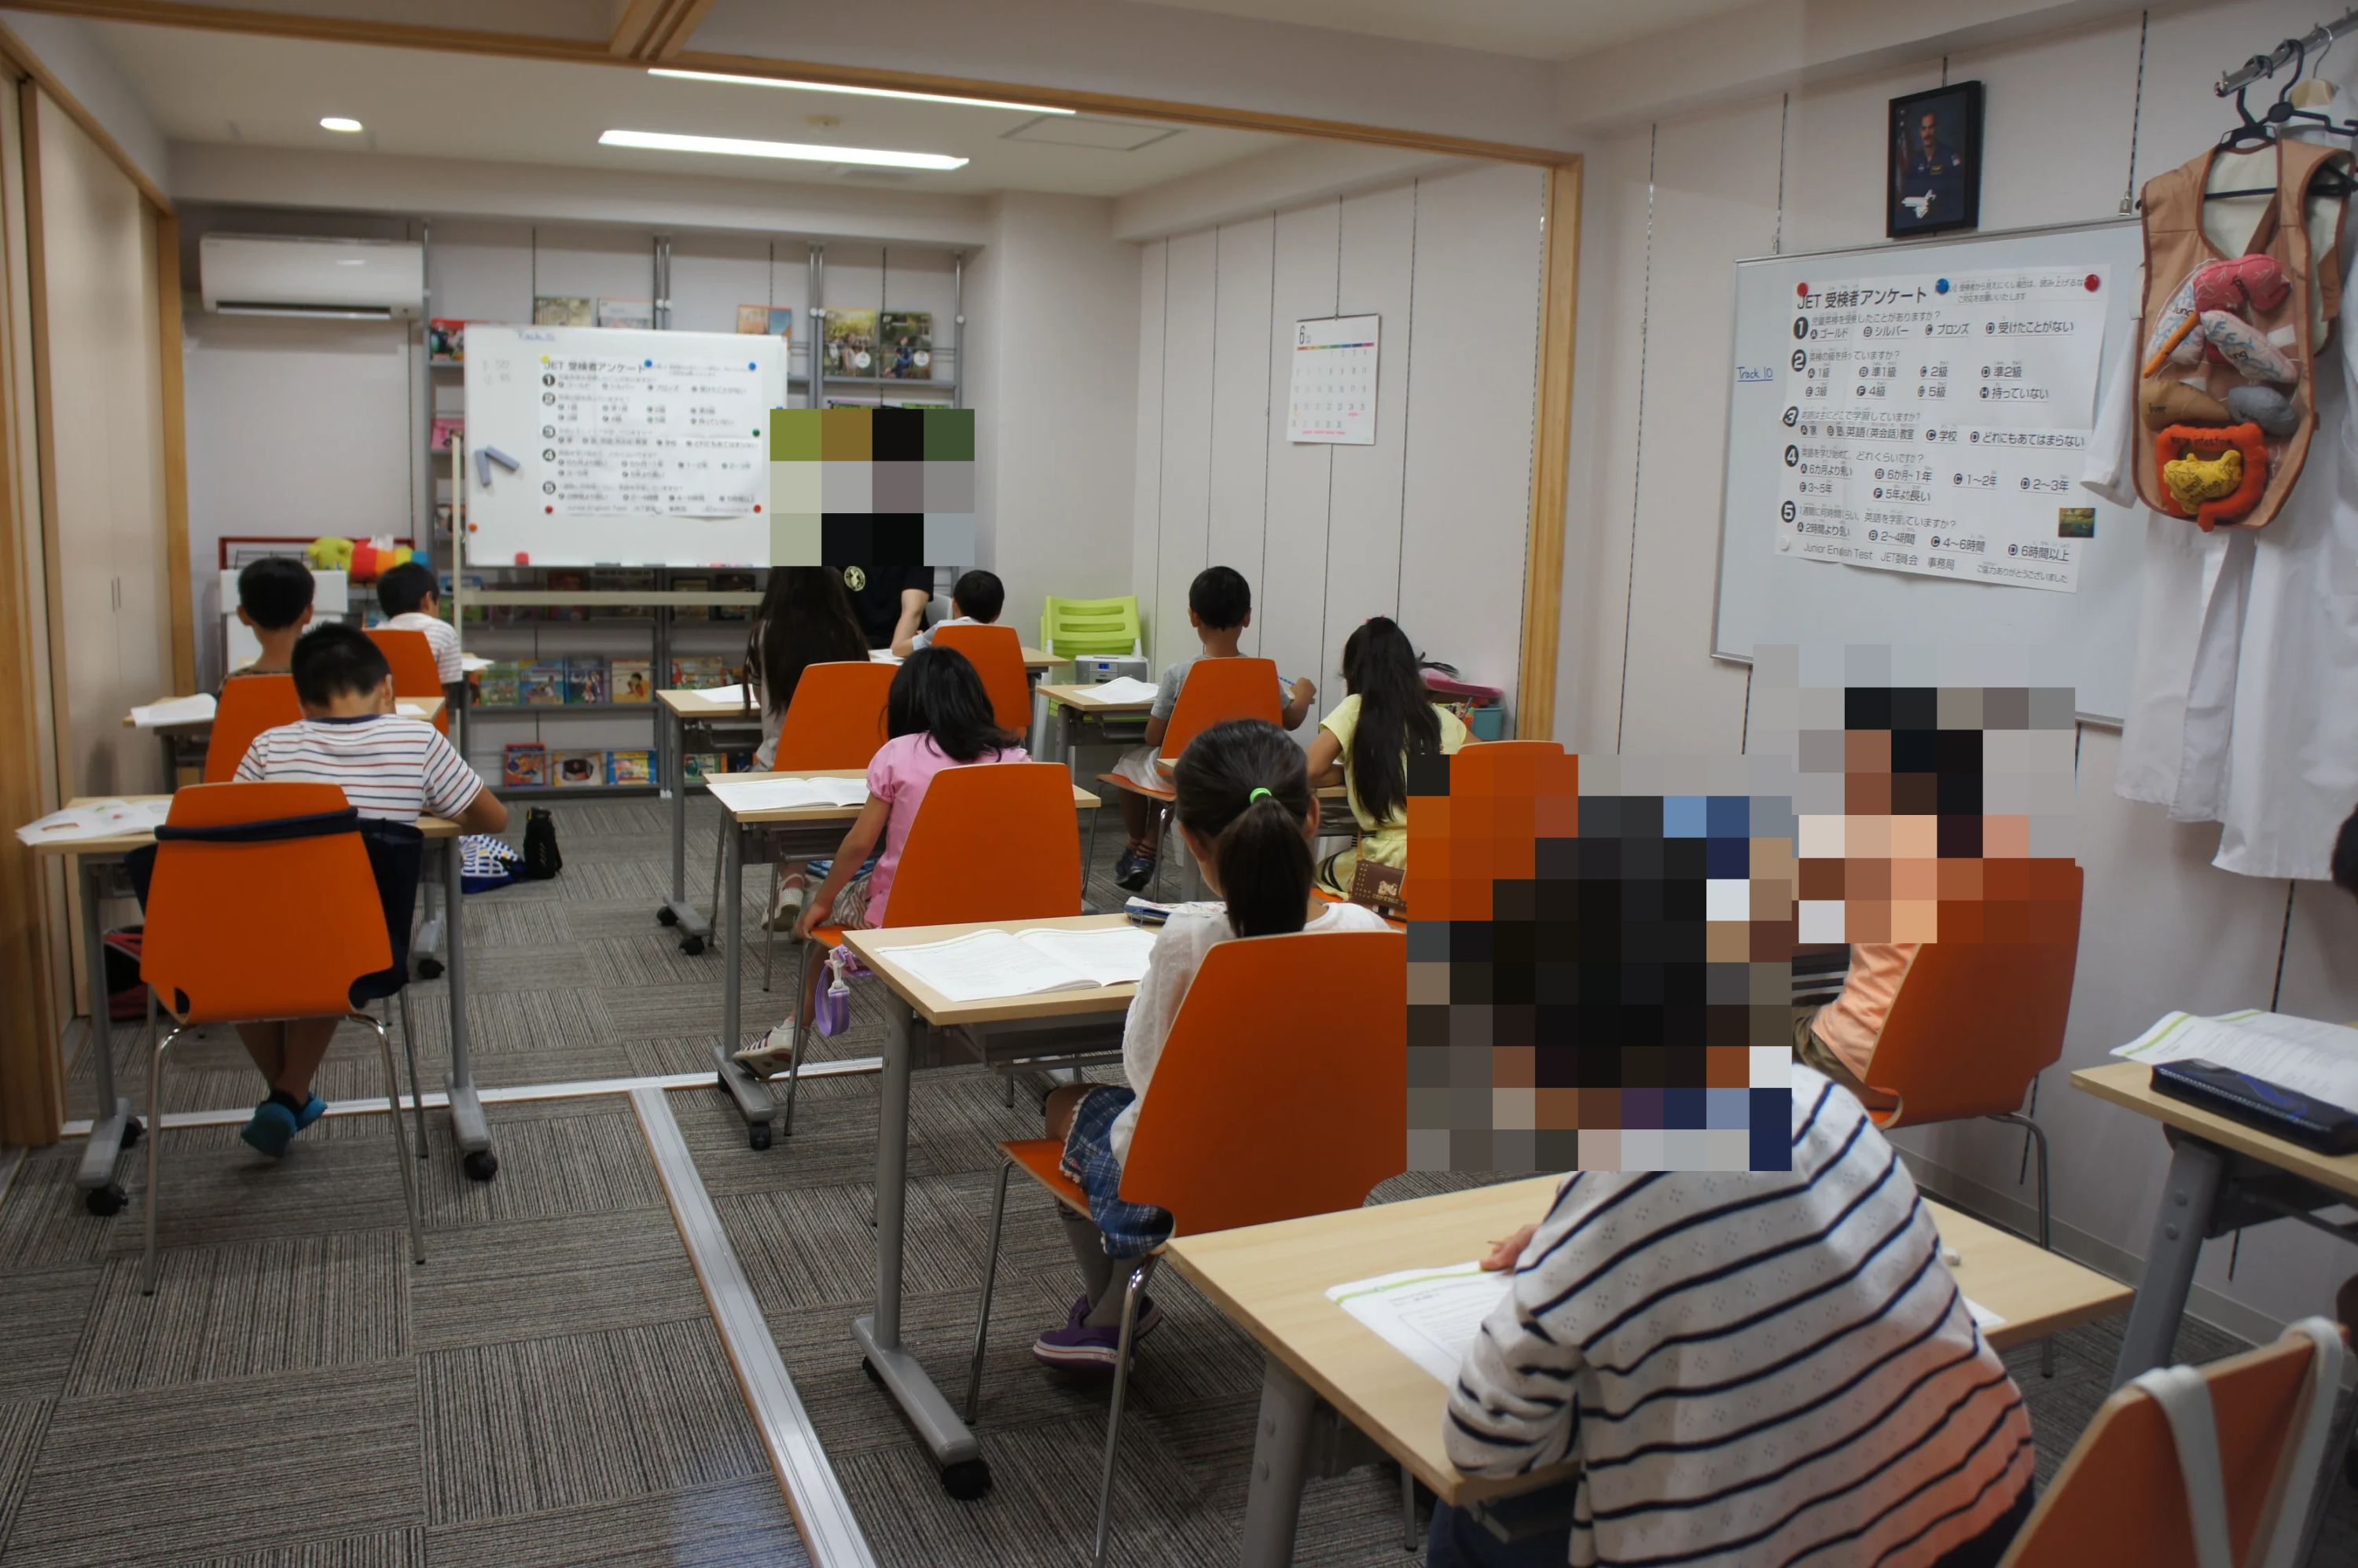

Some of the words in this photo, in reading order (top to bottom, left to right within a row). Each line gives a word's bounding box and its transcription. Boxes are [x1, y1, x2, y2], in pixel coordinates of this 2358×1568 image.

[1797, 294, 1821, 309] JET
[1824, 287, 1927, 309] 受検者アンケート
[1299, 325, 1305, 344] 6
[1820, 328, 1849, 339] ゴールド
[1875, 325, 1909, 336] シルバー
[1937, 322, 1970, 335] ブロンズ
[1998, 321, 2073, 334] 受けたことがない
[1736, 366, 1760, 379] Track
[1818, 368, 1831, 378] 1級
[1871, 366, 1897, 378] 準1級
[1930, 366, 1948, 378] 2級
[1993, 366, 2022, 378] 準2級
[1814, 386, 1828, 397] 3級
[1869, 386, 1886, 397] 4級
[1928, 386, 1946, 398] 5級
[1992, 387, 2049, 399] 持っていない
[1939, 430, 1958, 442] 学校
[1983, 432, 2085, 447] どれにもあてはまらない
[1784, 445, 1798, 467] 4
[1781, 500, 1796, 523] 5
[1804, 542, 1825, 553] Junior
[1855, 548, 1872, 560] Test
[1928, 557, 1956, 571] 事務局
[2022, 545, 2070, 562] 6時間以上
